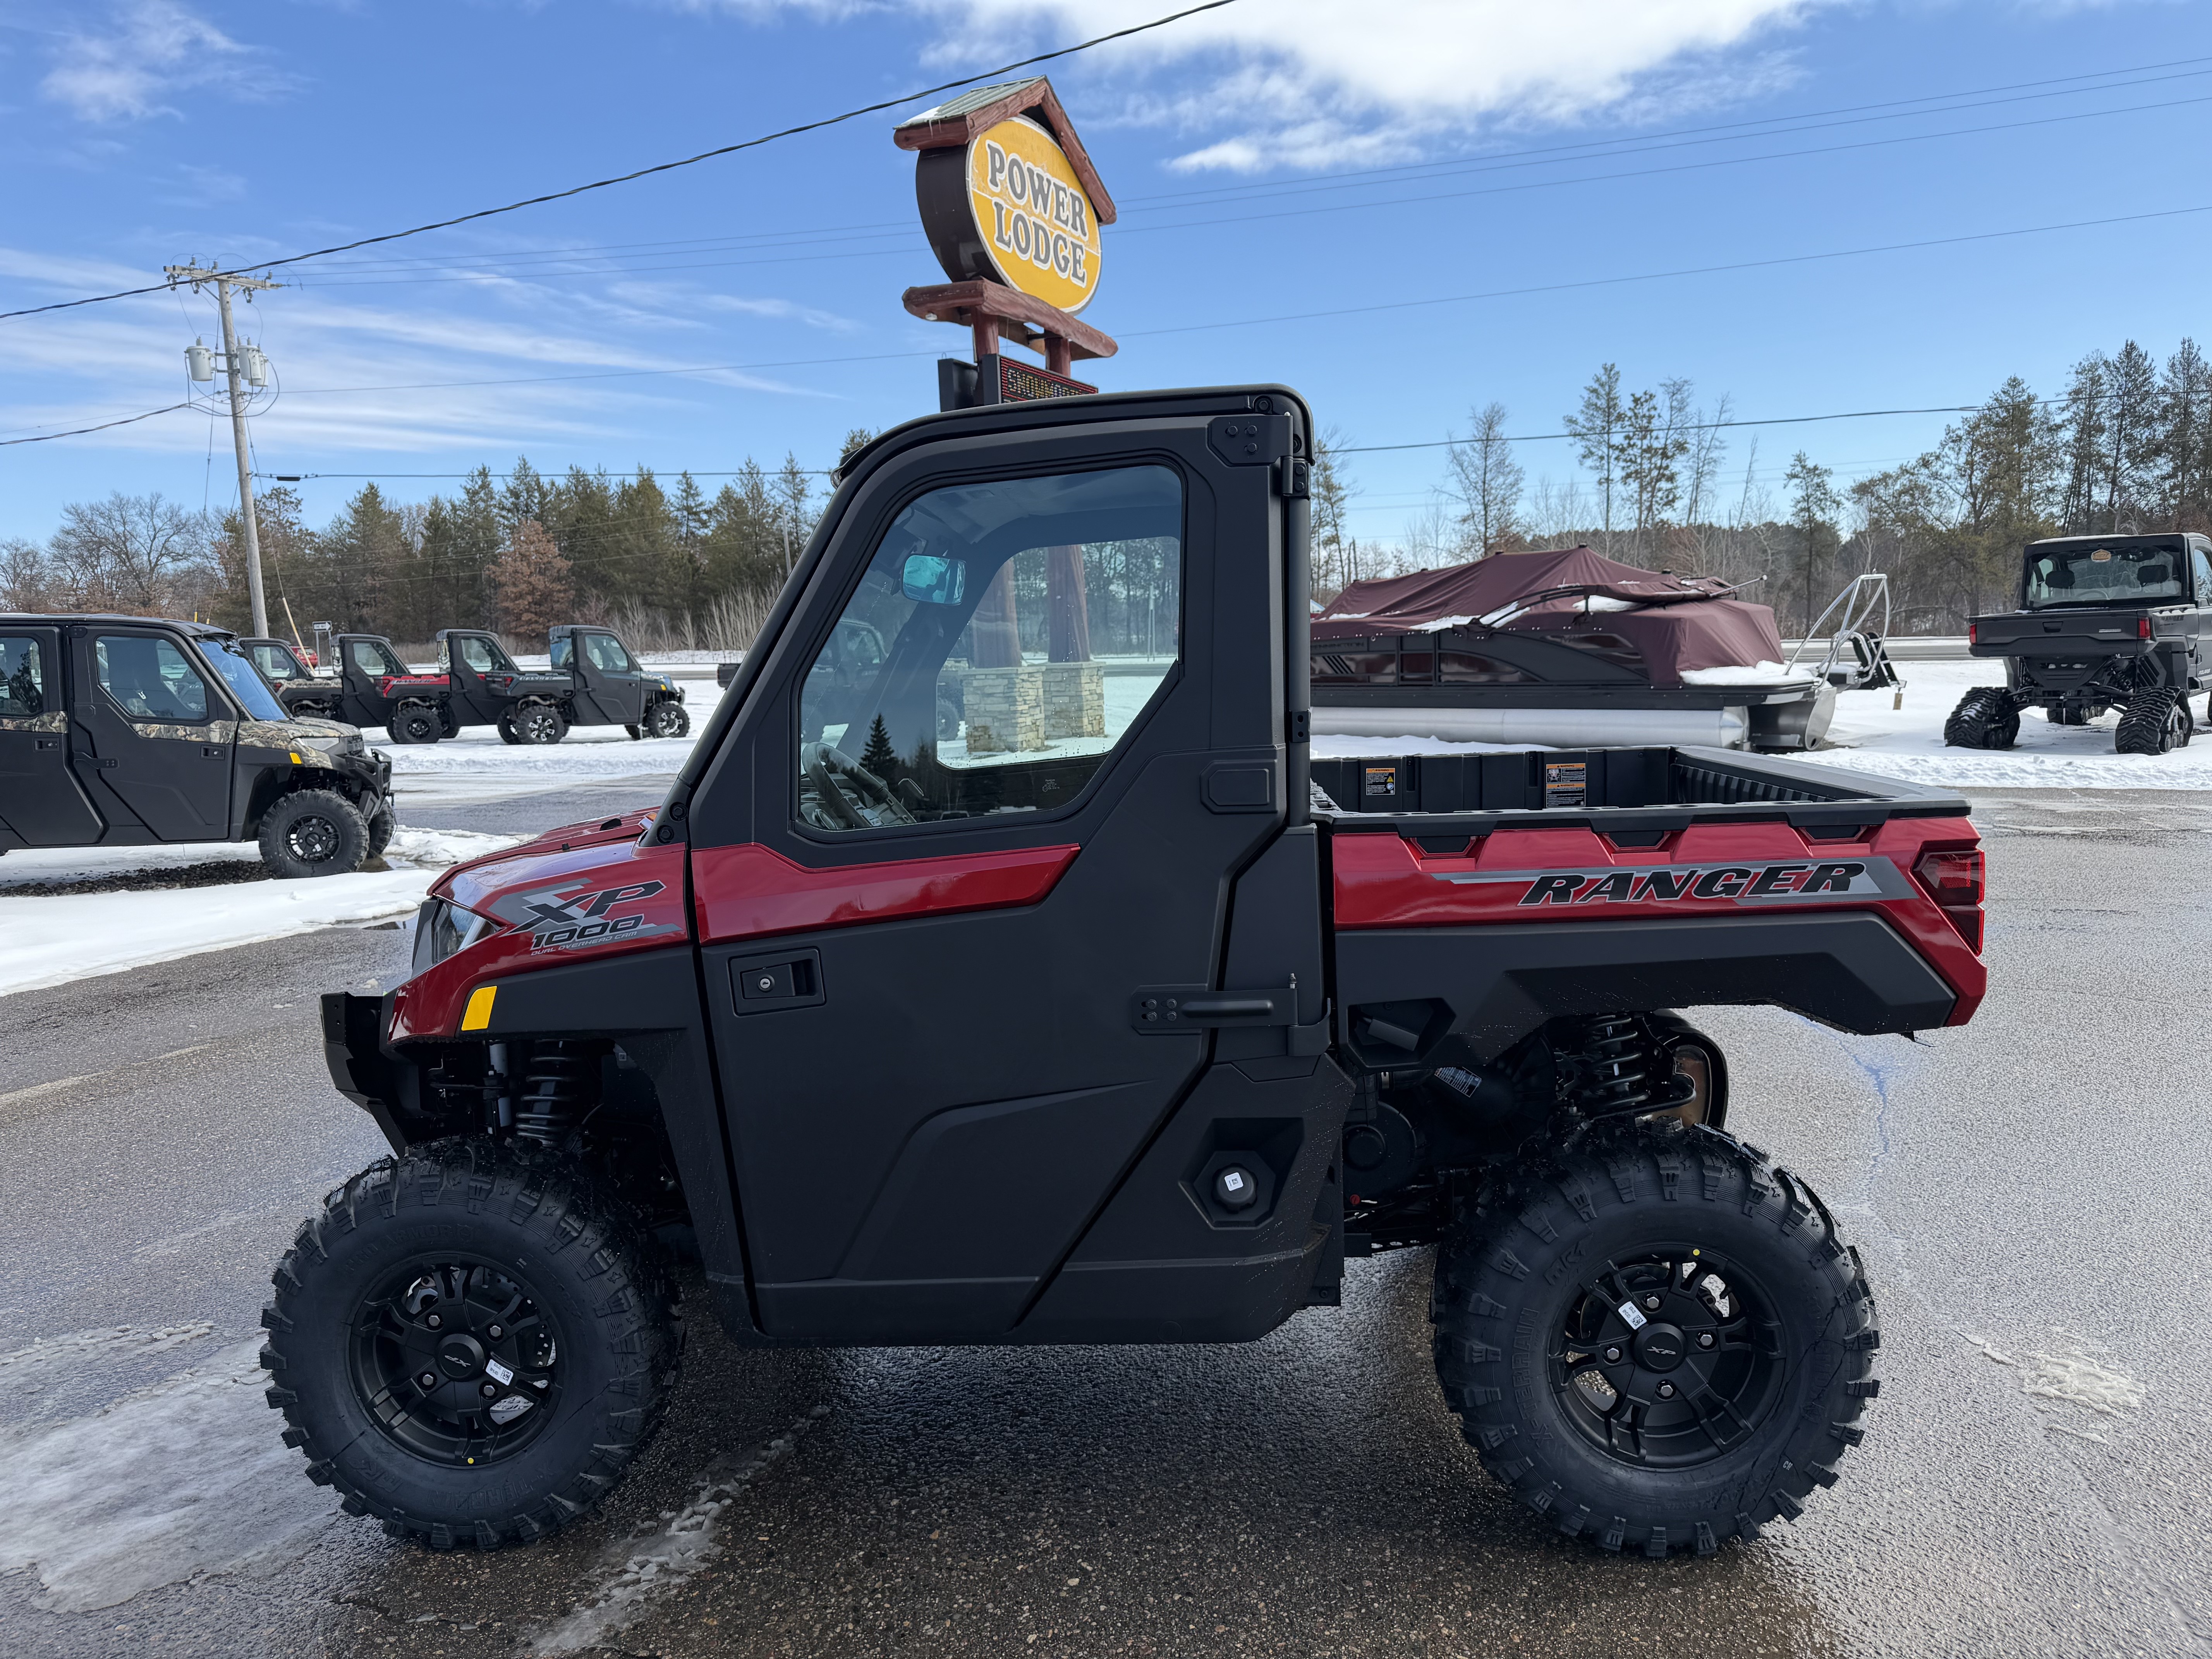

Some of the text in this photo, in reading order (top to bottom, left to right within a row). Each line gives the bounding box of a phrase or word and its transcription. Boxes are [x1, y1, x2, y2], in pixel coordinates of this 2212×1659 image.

[987, 141, 1087, 239] POWER
[993, 199, 1086, 285] LODGE
[1517, 861, 1866, 907] RANGER
[499, 879, 666, 937] XP
[530, 914, 644, 950] 1000
[531, 931, 637, 956] DUAL OVERHEAD CAM
[381, 1222, 453, 1250] ARMOR
[445, 1355, 471, 1367] XP
[1647, 1346, 1676, 1355] XP
[1512, 1307, 1554, 1447] X-TERRAIN
[427, 1466, 560, 1510] X-TERRAIN
